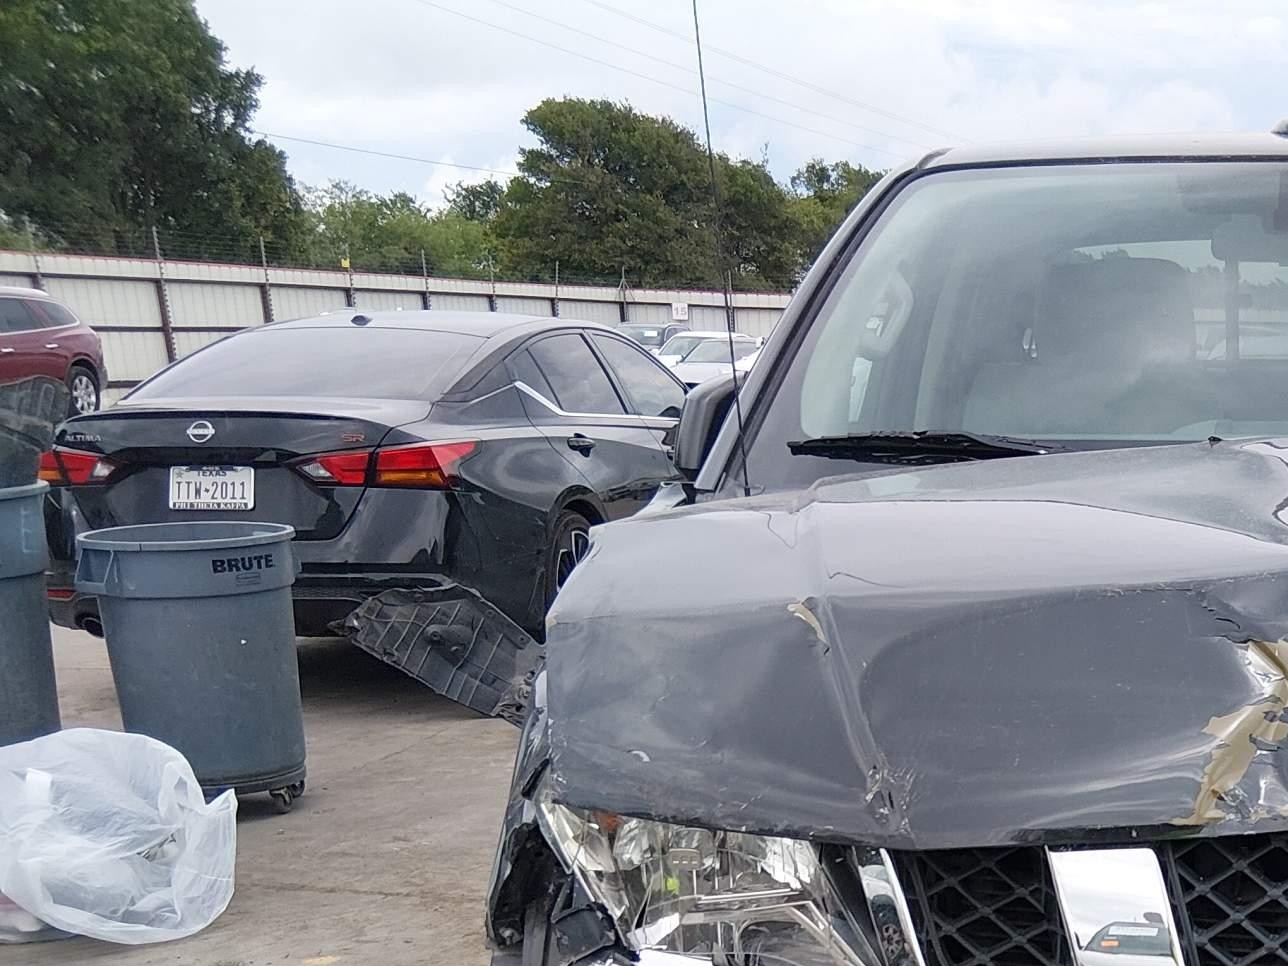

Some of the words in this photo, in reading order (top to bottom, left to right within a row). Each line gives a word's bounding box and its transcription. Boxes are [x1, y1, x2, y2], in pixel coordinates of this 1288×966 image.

[65, 434, 102, 442] ALTIMA
[342, 433, 365, 442] SR
[197, 470, 227, 478] TEXAS
[175, 481, 202, 500] TTW
[211, 481, 247, 500] 2011
[211, 553, 275, 574] BRUTE
